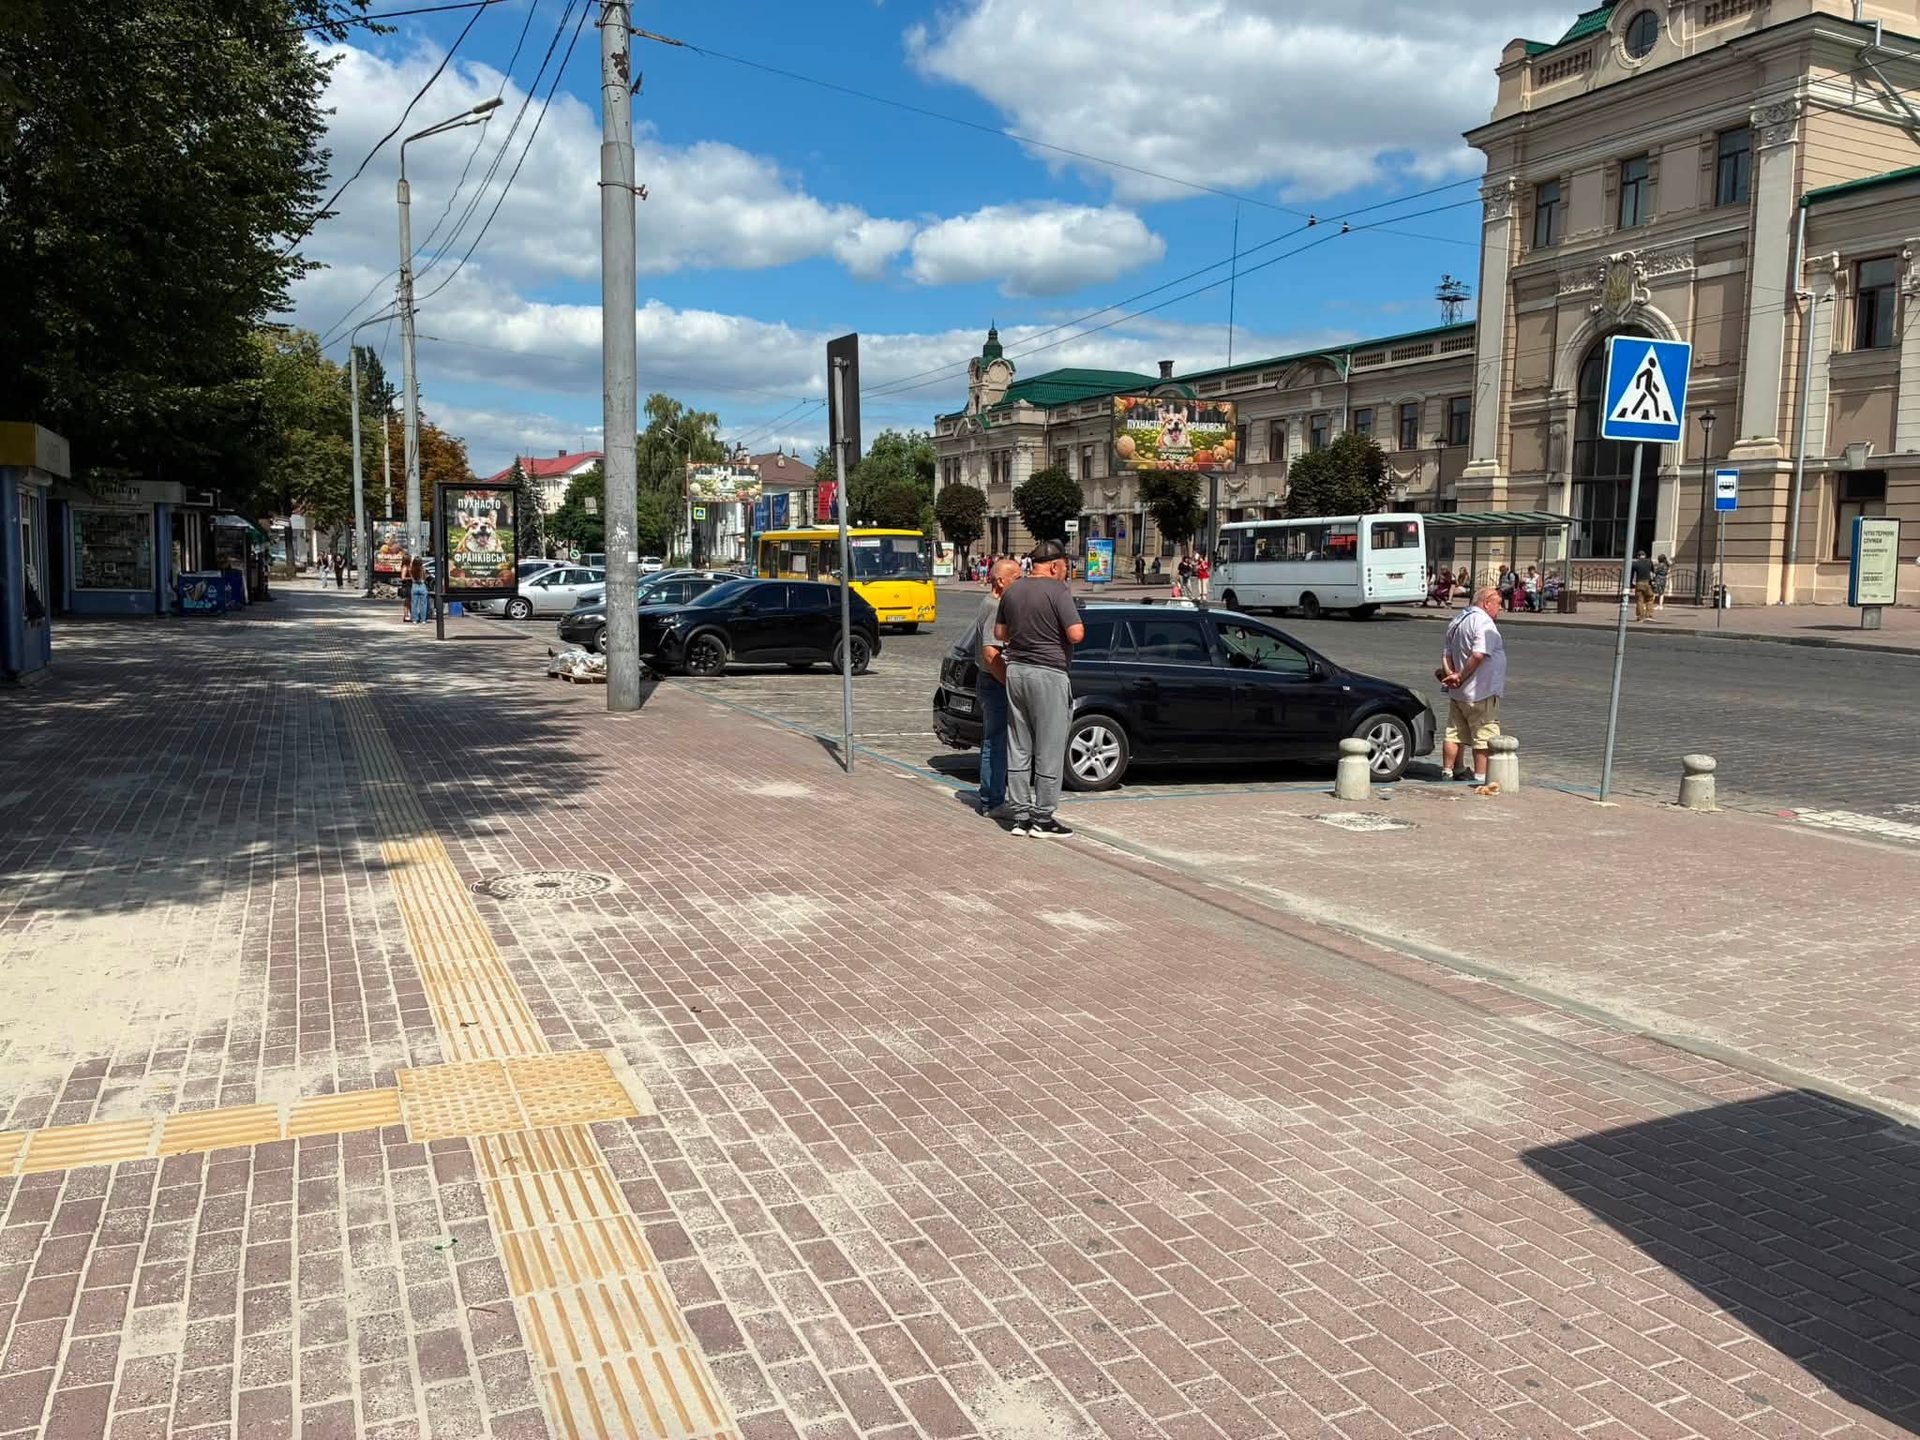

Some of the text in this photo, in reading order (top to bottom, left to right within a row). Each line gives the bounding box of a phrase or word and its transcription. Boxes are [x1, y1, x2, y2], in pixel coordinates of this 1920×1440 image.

[1127, 419, 1162, 430] ПУХНАСТО
[458, 499, 501, 509] ПУХНАСТО
[454, 553, 507, 563] ФРАНКІВСЬК
